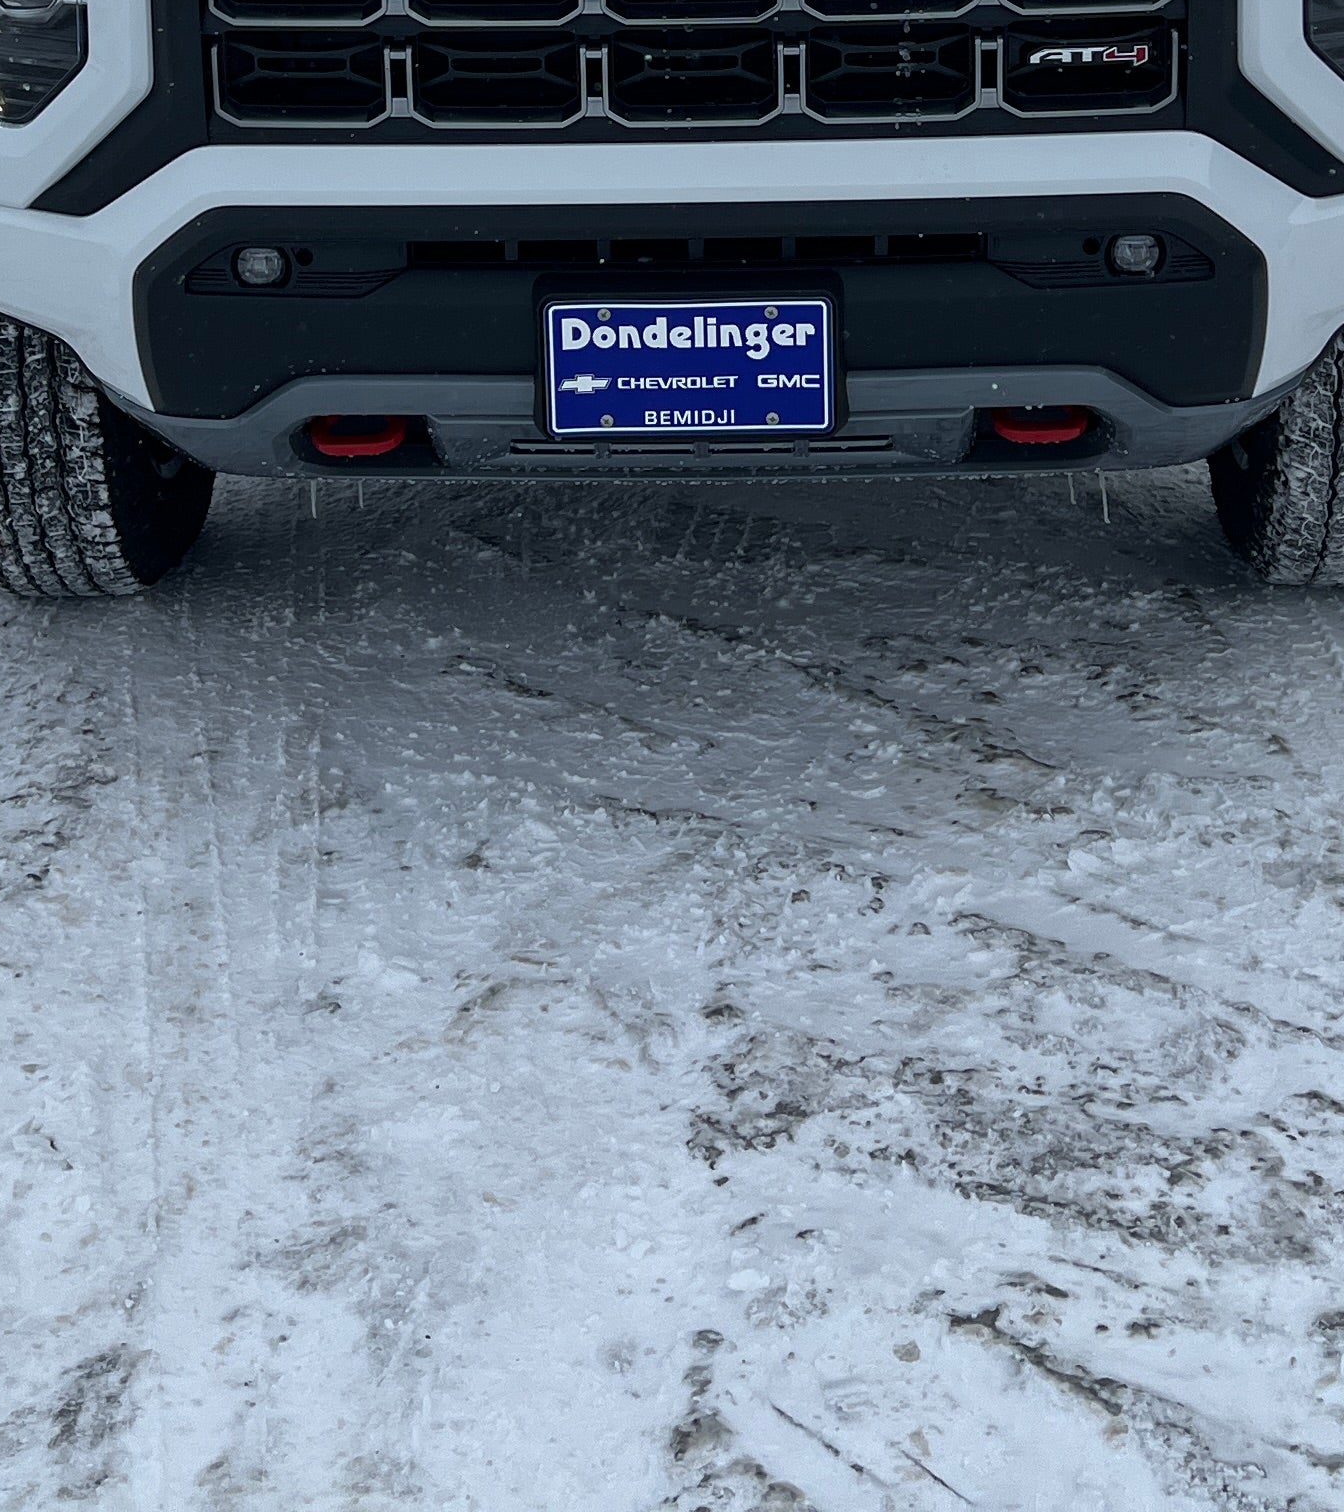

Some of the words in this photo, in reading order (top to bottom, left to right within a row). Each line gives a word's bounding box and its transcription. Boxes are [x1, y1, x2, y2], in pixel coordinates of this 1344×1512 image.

[1029, 45, 1149, 66] AT4
[560, 316, 816, 360] Dondelinger
[616, 375, 739, 389] CHEVROLET
[757, 374, 821, 388] GMC
[643, 409, 736, 425] BEMIDJI
